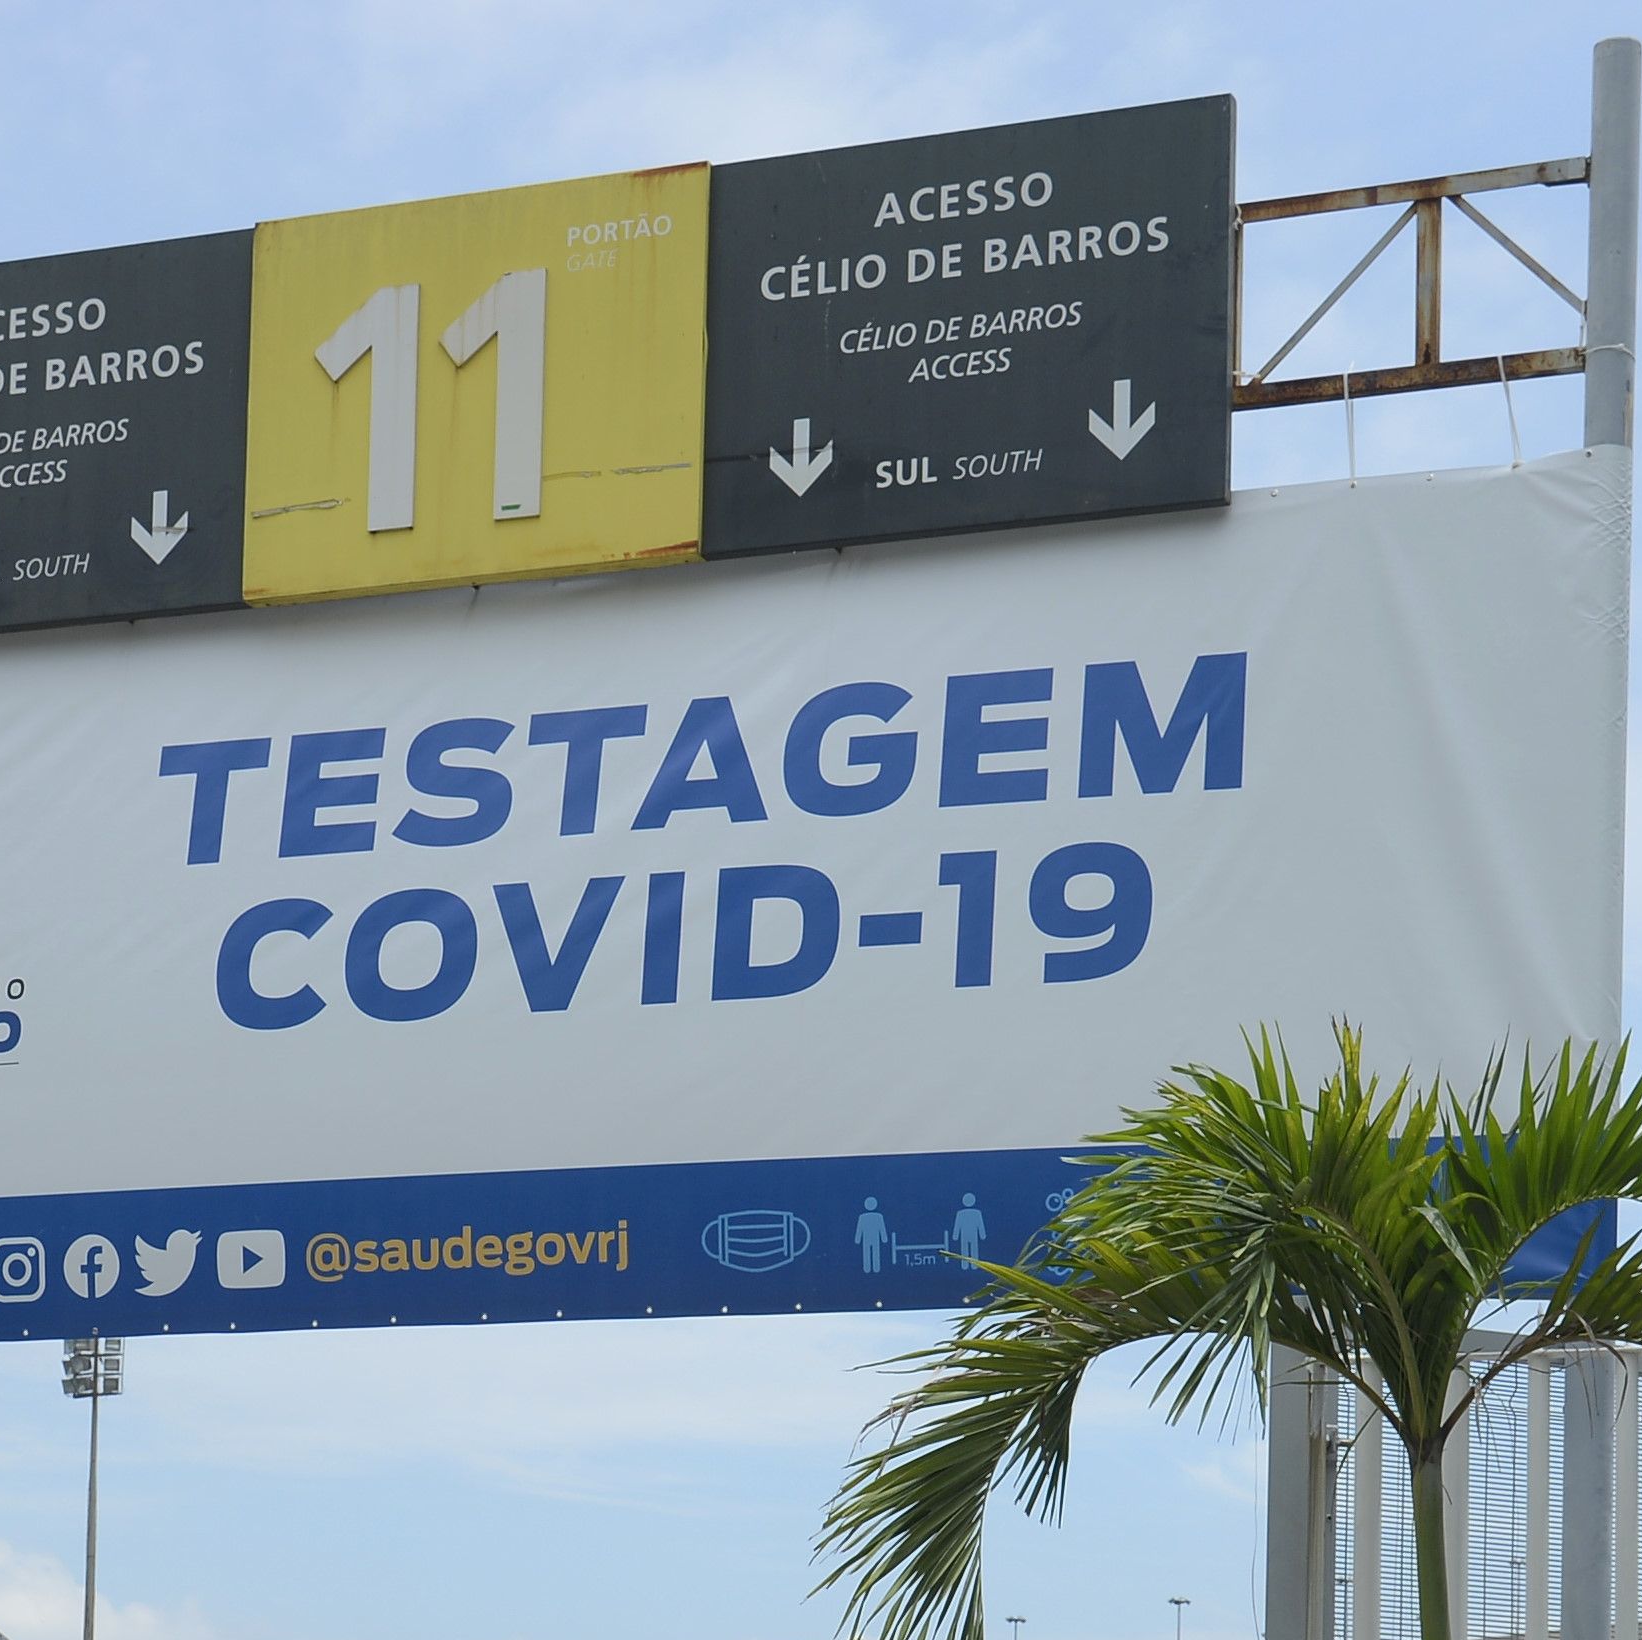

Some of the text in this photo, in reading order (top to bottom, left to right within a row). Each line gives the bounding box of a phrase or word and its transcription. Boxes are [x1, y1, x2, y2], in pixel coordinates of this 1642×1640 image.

[874, 172, 1052, 227] ACESSO
[567, 213, 672, 246] PORTÃO
[761, 217, 1168, 300] CÉLIO DE BARROS
[840, 302, 1082, 353] CÉLIO DE BARROS
[46, 342, 203, 390] BARROS
[909, 348, 1011, 382] ACCESS
[314, 268, 548, 533] 11
[32, 419, 129, 450] BARROS
[876, 449, 1042, 488] SUL SOUTH
[13, 553, 89, 580] SOUTH
[159, 652, 1247, 865] TESTAGEM
[217, 842, 1152, 1030] COVID-19
[305, 1220, 628, 1283] @saudegovrj
[905, 1253, 935, 1266] 1,5m
